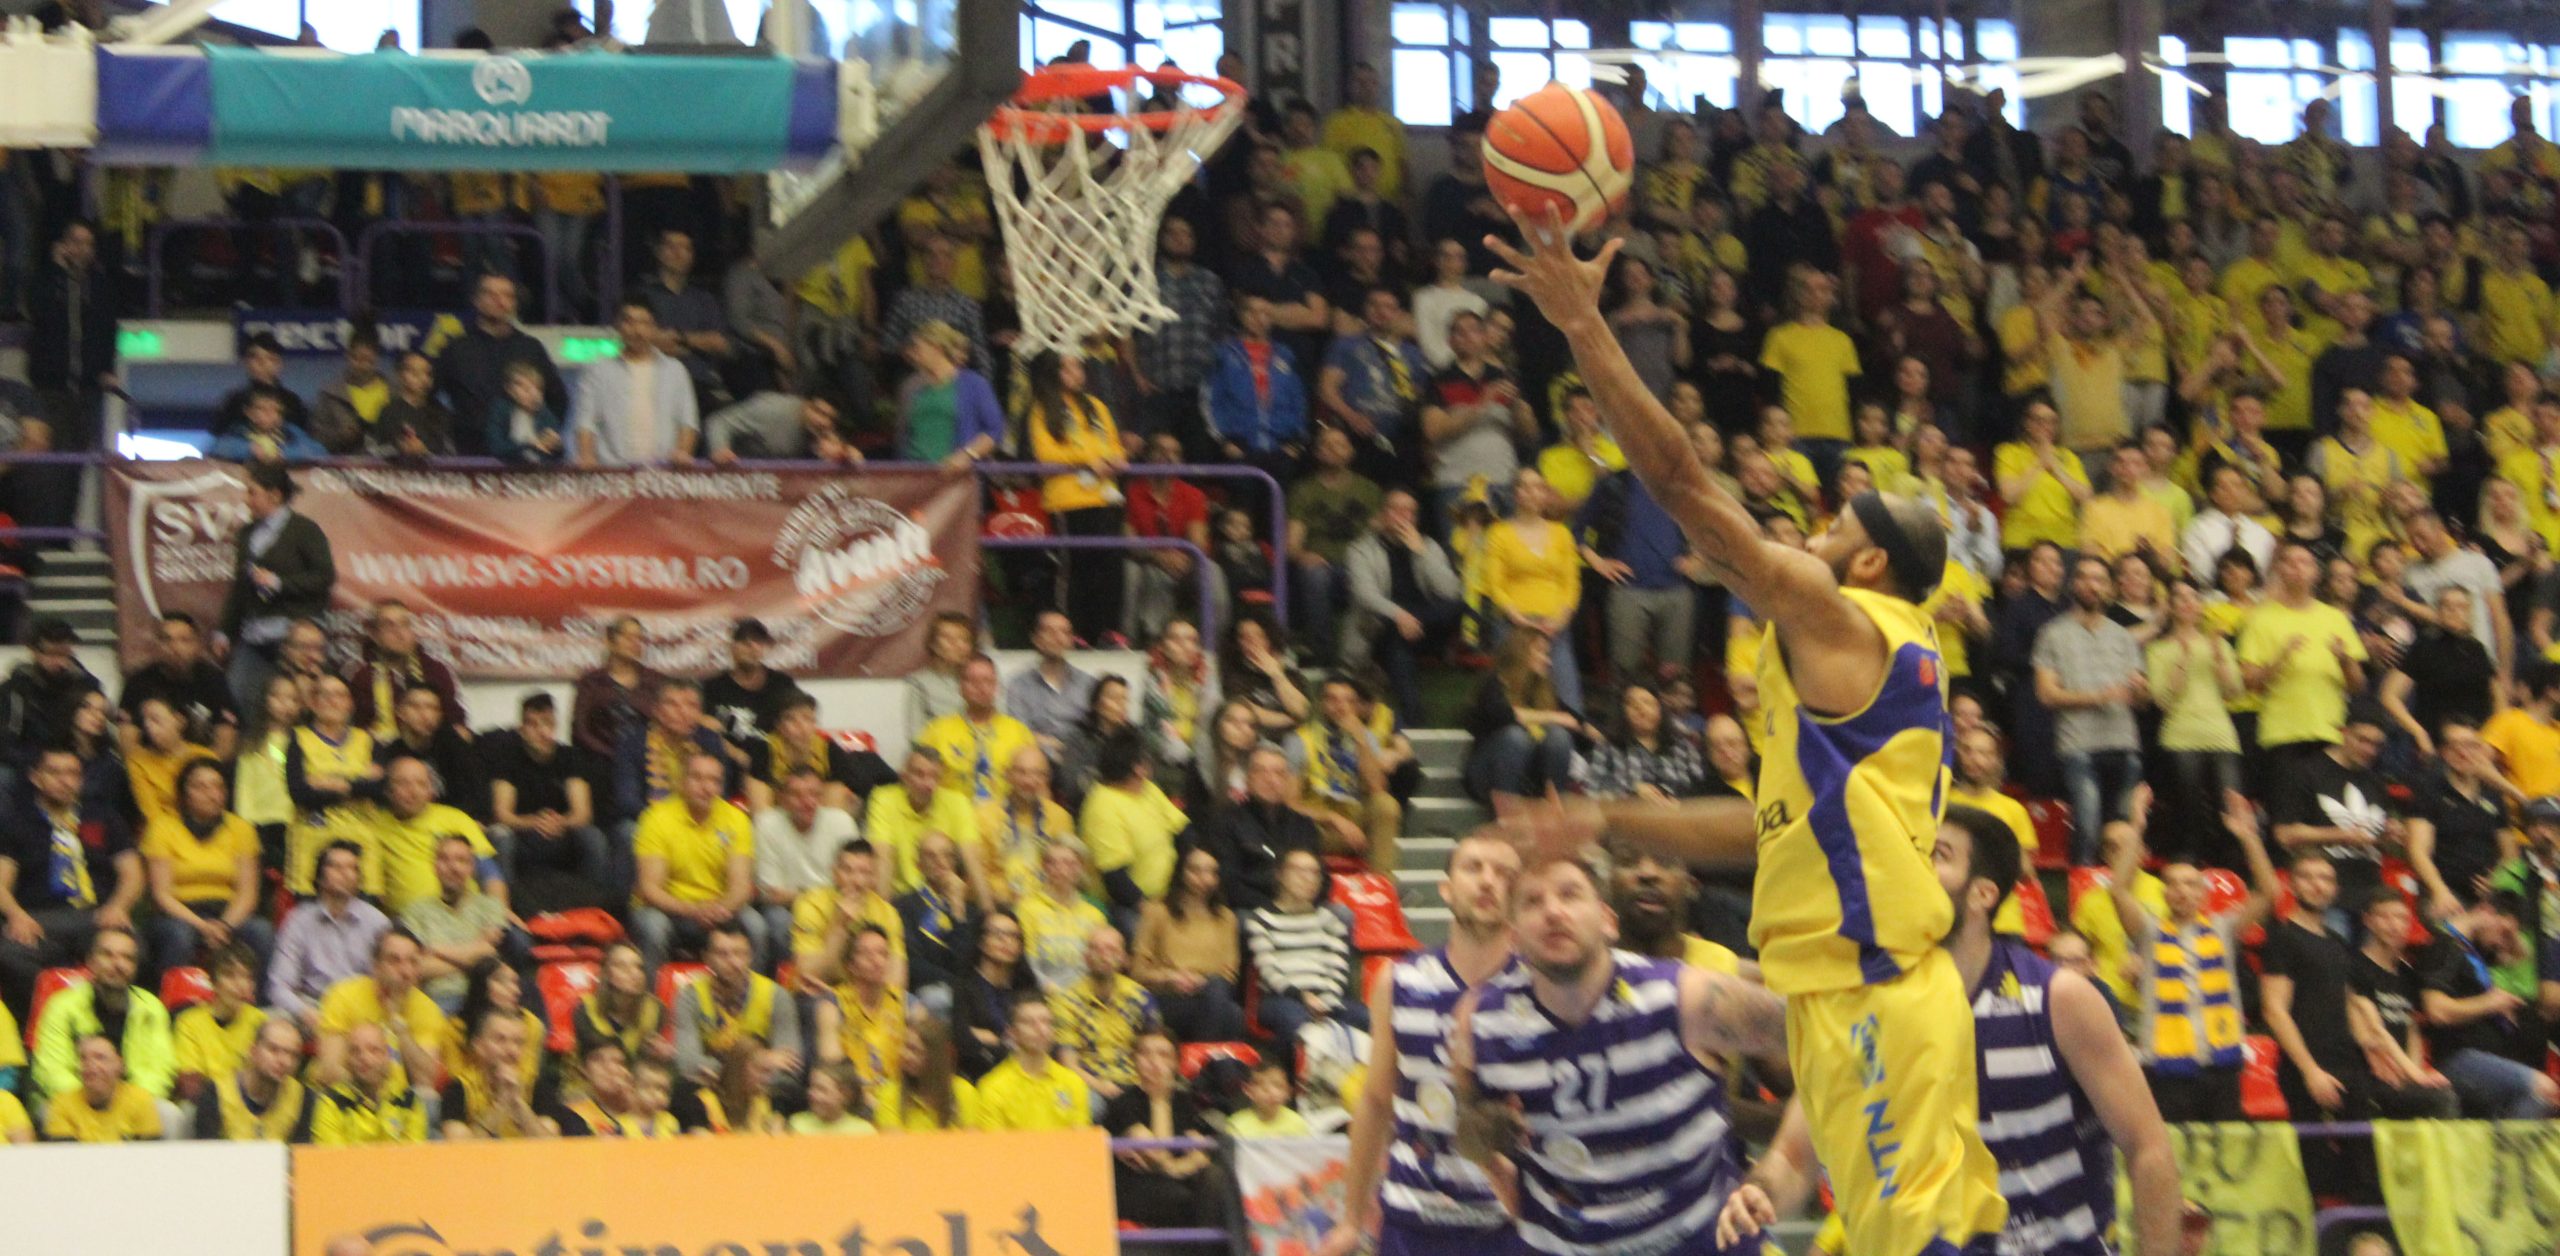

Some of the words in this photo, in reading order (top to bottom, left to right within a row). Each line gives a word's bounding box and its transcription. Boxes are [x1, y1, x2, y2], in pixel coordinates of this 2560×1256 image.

[391, 106, 612, 147] MARQUARDT
[153, 501, 252, 545] SV
[349, 551, 751, 590] WWW.SVS-SYSTEM.RO
[1550, 1053, 1610, 1121] 27
